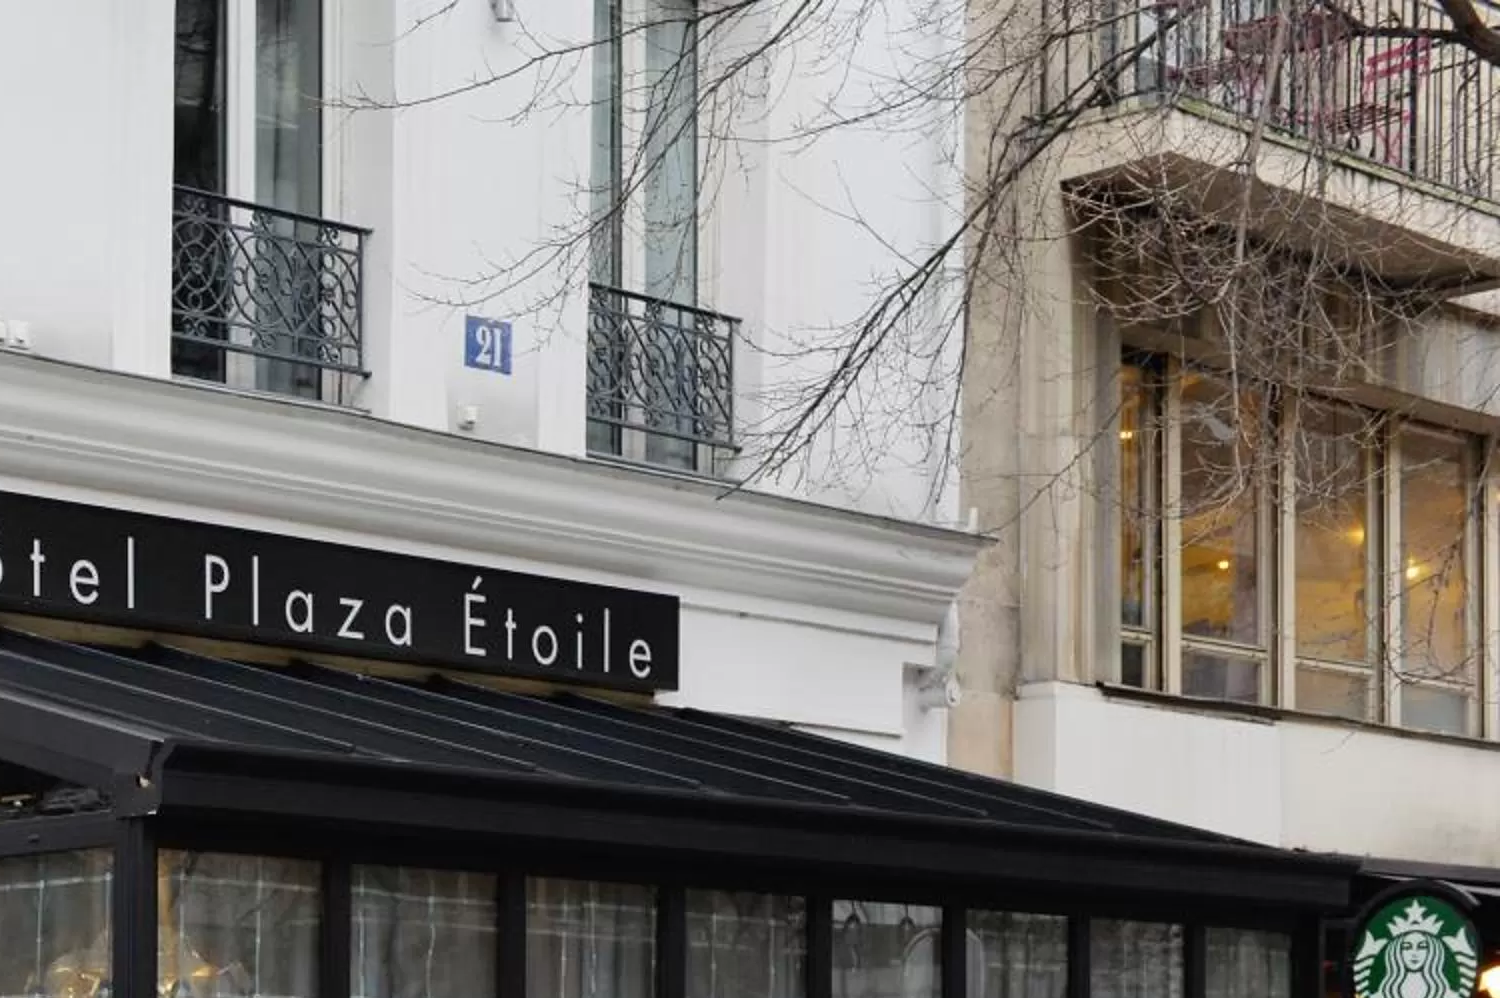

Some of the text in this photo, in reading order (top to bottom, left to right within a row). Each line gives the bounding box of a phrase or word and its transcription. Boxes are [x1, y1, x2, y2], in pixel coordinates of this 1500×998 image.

[475, 325, 502, 367] 21
[204, 553, 413, 647] Plaza
[463, 575, 653, 679] Étoile
